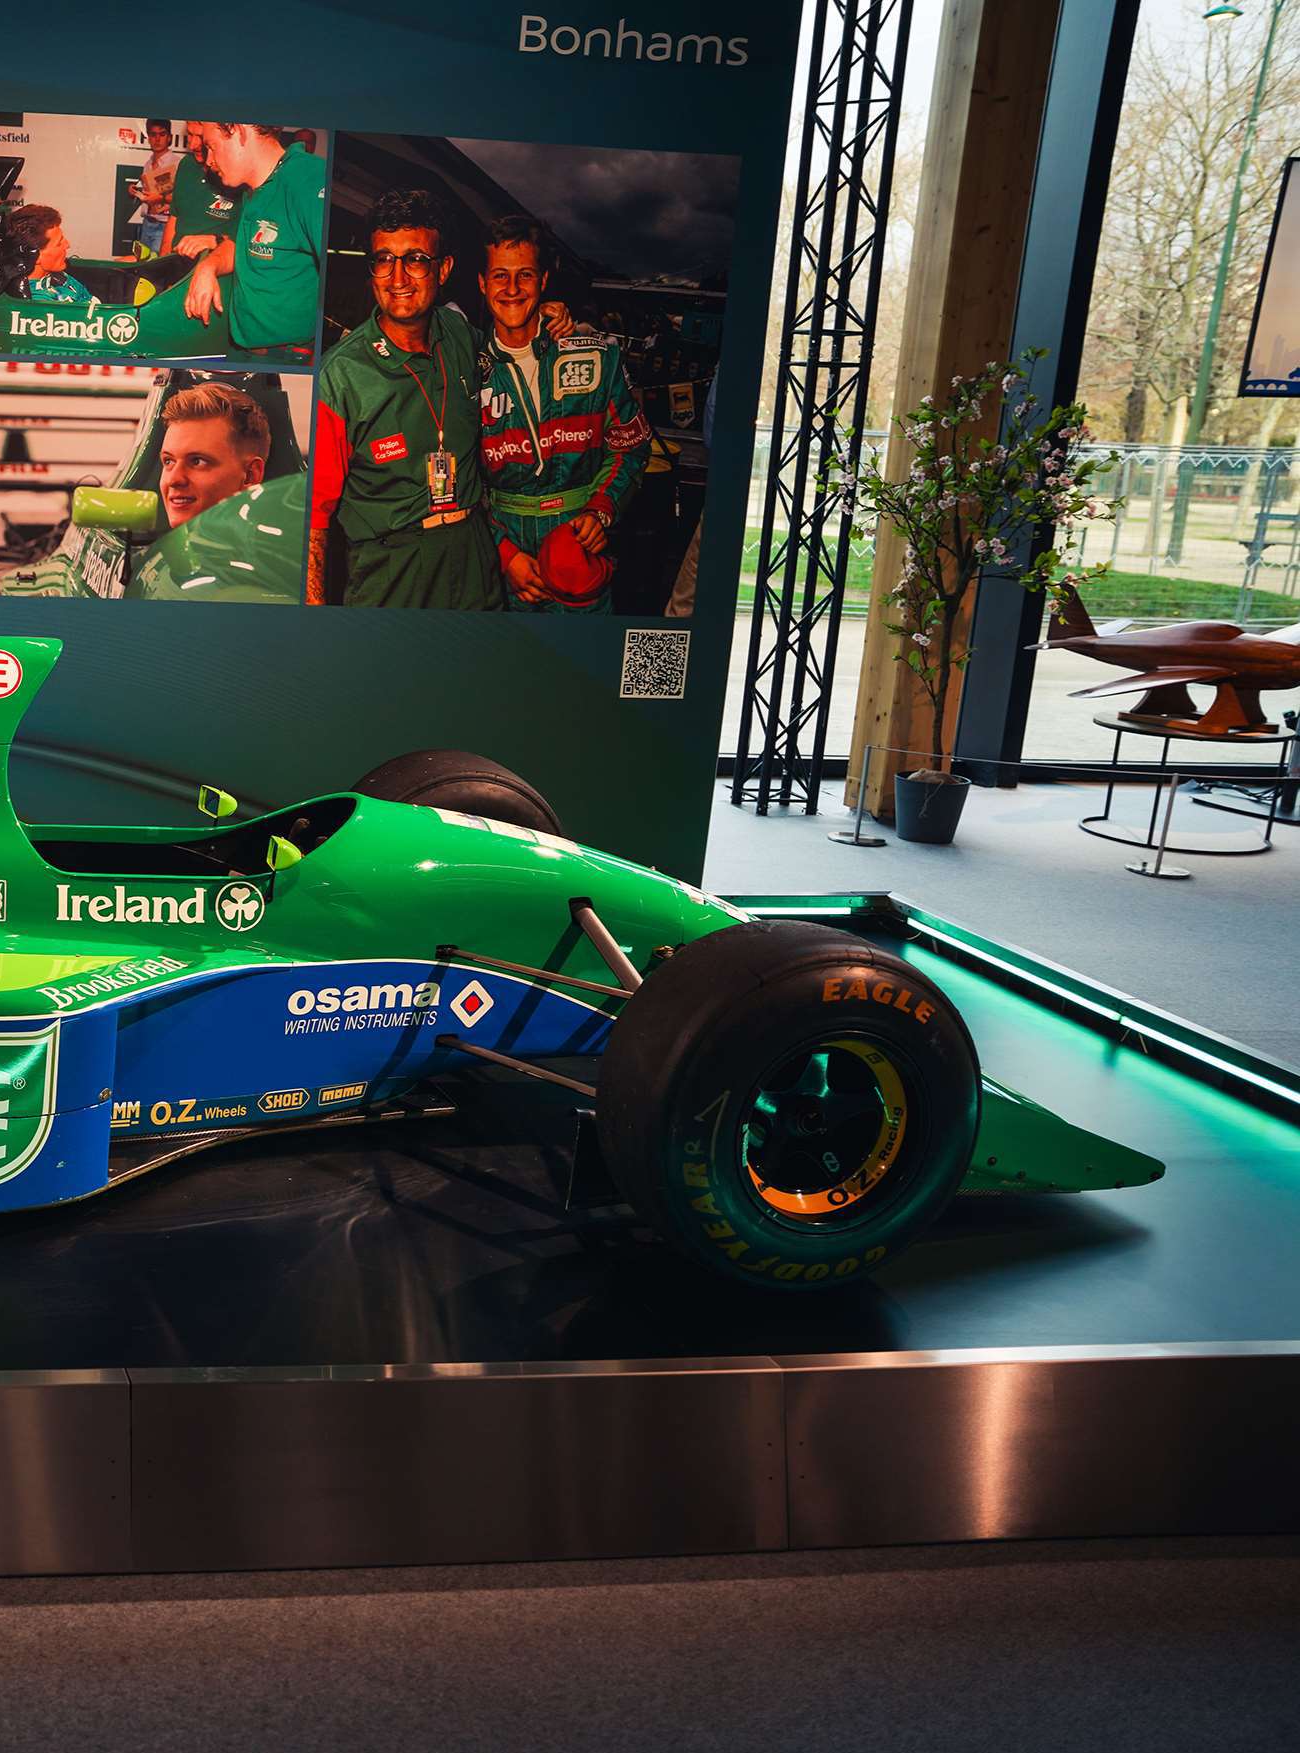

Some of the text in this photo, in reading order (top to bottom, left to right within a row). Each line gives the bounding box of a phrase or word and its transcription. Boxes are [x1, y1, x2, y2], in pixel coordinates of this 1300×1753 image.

[518, 15, 749, 66] Bonhams
[9, 310, 104, 340] Ireland
[561, 372, 590, 387] tac
[565, 361, 590, 376] tic
[553, 428, 594, 445] Stereo
[55, 884, 207, 924] Ireland
[35, 955, 189, 1010] Brooksfield
[287, 982, 441, 1016] osama
[821, 976, 937, 1025] EAGLE
[283, 1010, 438, 1036] WRITING INSTRUMENTS
[264, 1091, 304, 1110] SHOEI
[321, 1083, 365, 1103] momo
[149, 1098, 203, 1126] O.Z.
[204, 1104, 248, 1120] Wheels
[880, 1106, 904, 1162] Racing
